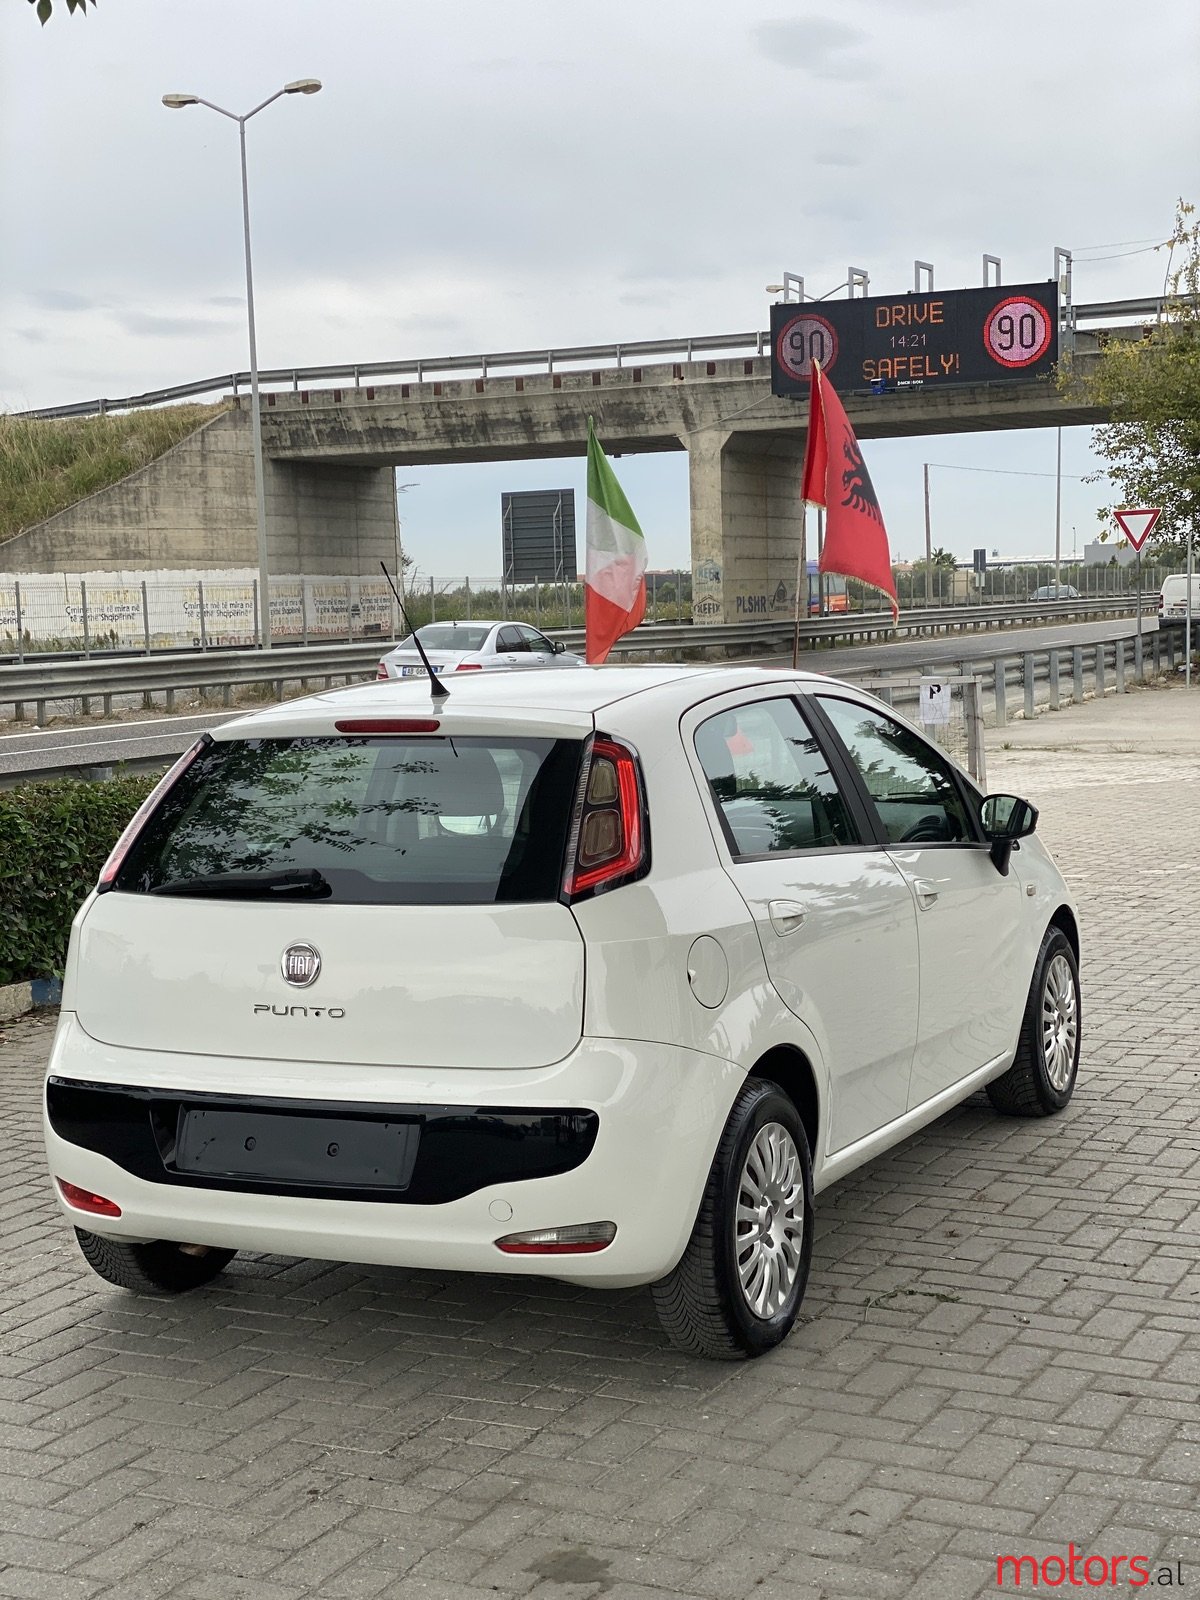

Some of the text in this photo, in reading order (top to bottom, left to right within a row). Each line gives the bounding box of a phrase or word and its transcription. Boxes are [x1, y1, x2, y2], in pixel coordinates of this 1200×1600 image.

[876, 301, 944, 328] DRIVE
[889, 334, 927, 348] 14:21
[997, 313, 1036, 351] 90
[789, 329, 825, 366] 90
[862, 353, 960, 381] SAFELY!
[736, 596, 767, 613] PLSHR
[929, 684, 941, 699] P
[289, 956, 311, 975] FIAT
[253, 1004, 345, 1019] PUNTO
